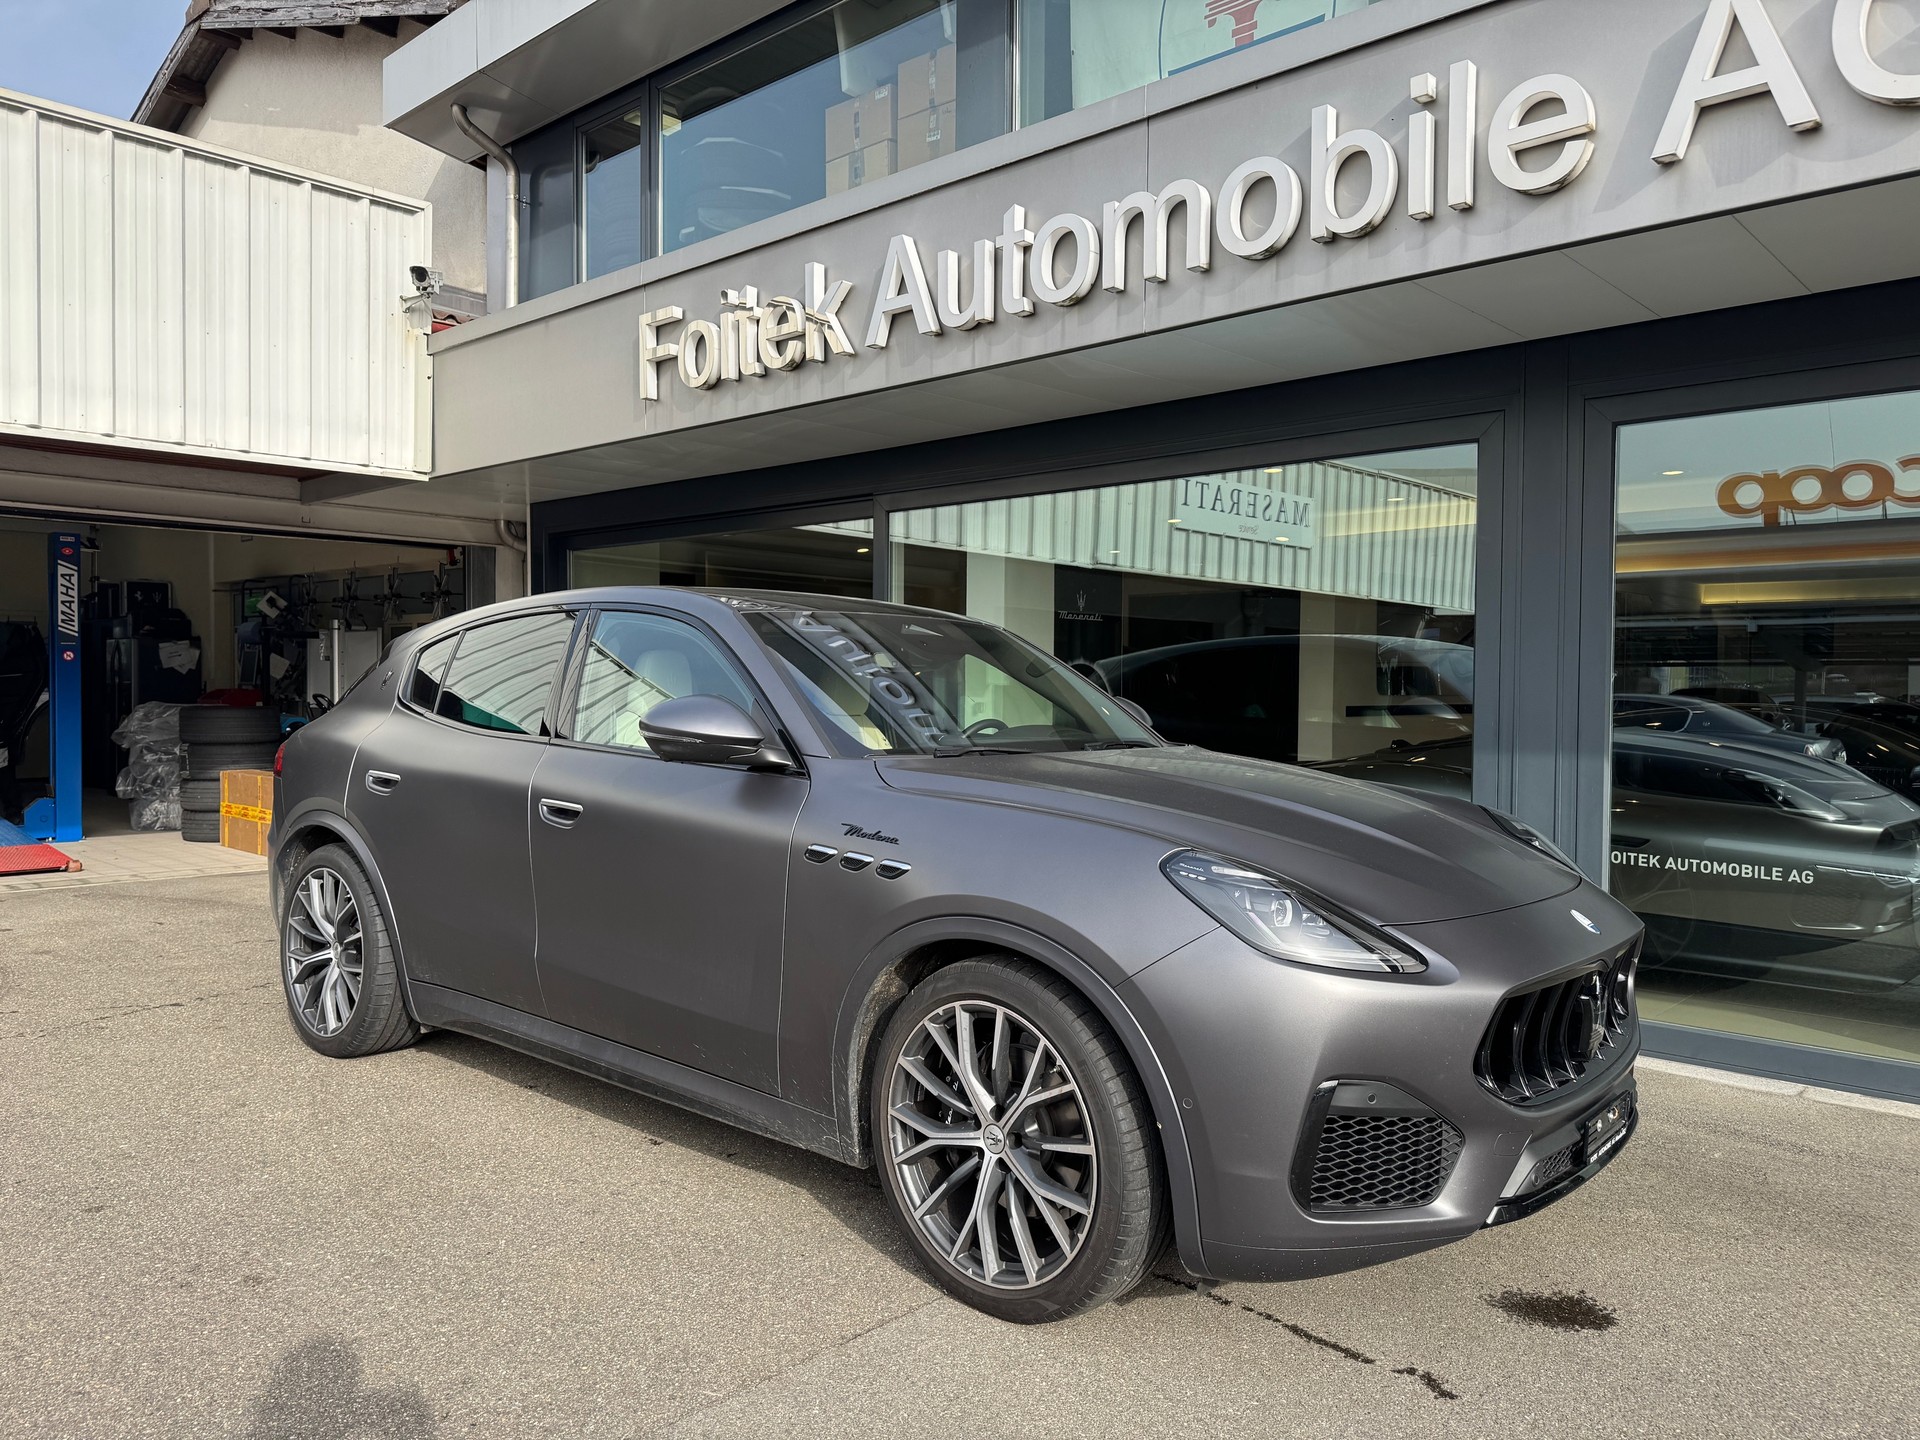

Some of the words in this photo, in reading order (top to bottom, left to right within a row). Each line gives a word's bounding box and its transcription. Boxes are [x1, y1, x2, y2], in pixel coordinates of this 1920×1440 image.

[639, 262, 855, 401] Foitek
[864, 60, 1597, 350] Automobile
[60, 573, 75, 628] MAHA
[841, 823, 899, 845] Modena
[1611, 851, 1660, 868] OITEK
[1665, 856, 1783, 882] AUTOMOBILE
[1788, 869, 1814, 885] AG
